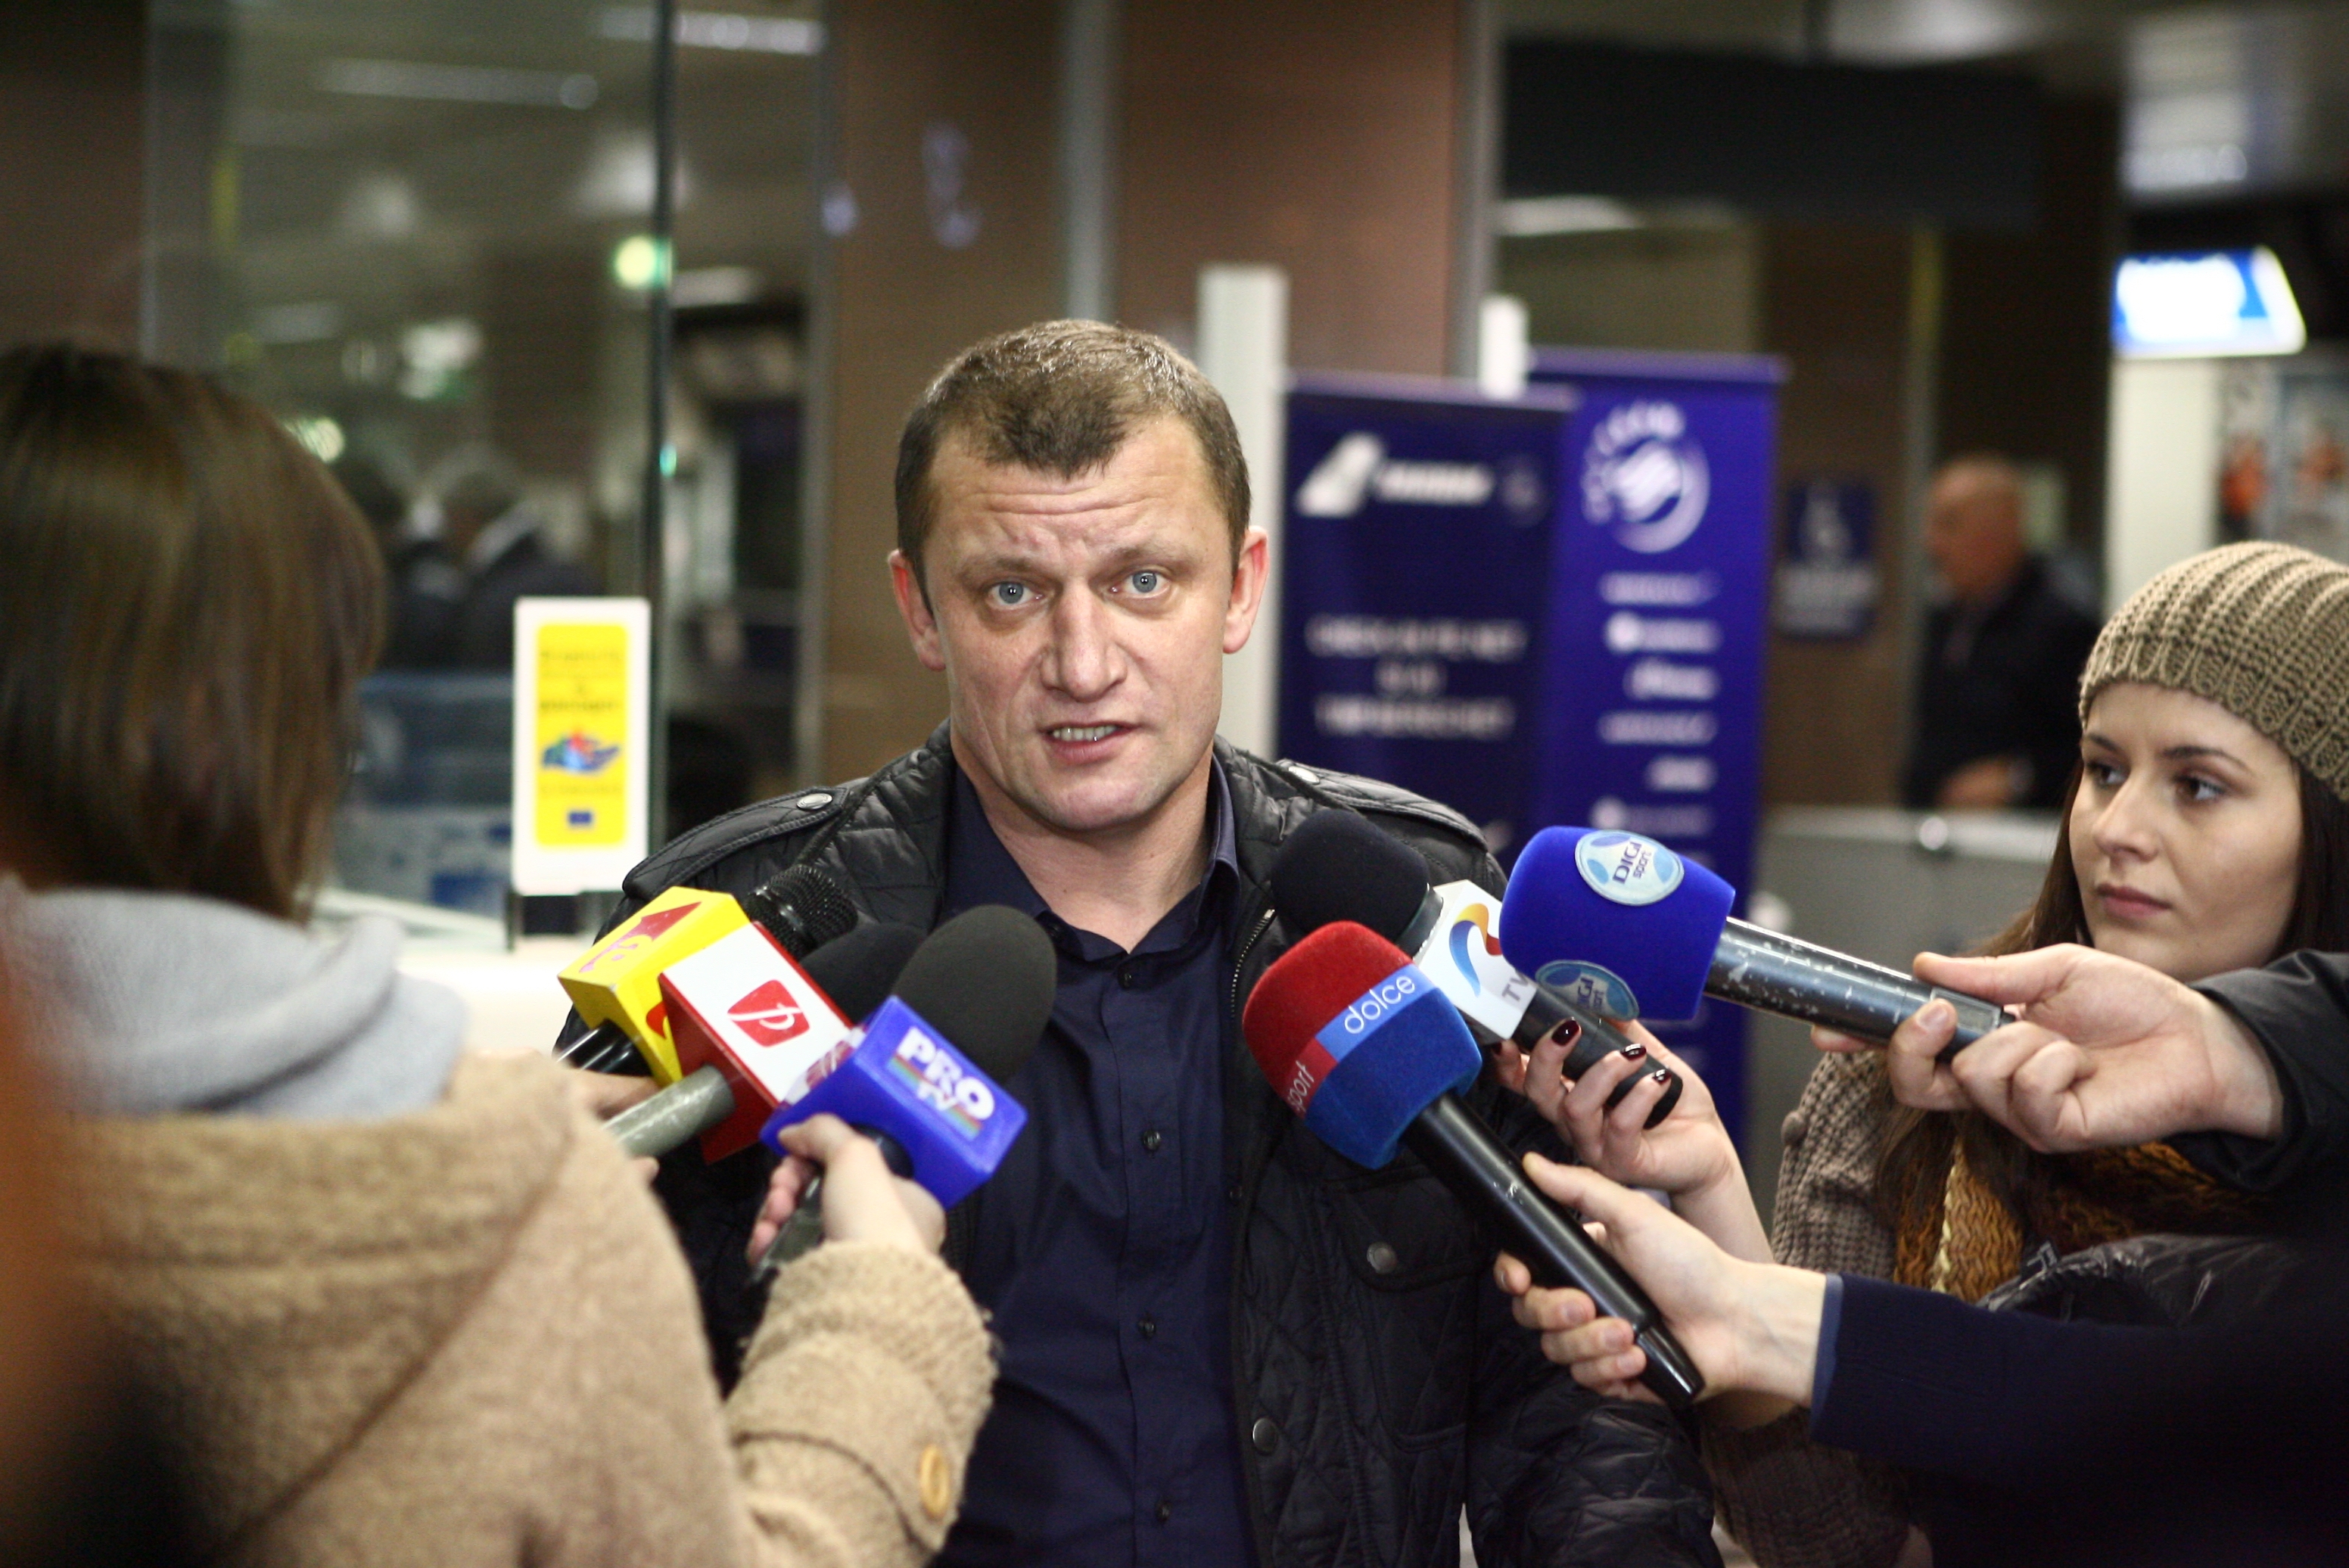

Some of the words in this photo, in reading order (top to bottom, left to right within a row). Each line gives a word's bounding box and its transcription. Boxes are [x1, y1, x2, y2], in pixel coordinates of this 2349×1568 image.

[1613, 841, 1642, 885] DIGI
[1633, 851, 1651, 879] sport
[1344, 975, 1416, 1034] dolce
[896, 1026, 995, 1121] PRO
[916, 1079, 960, 1112] TV
